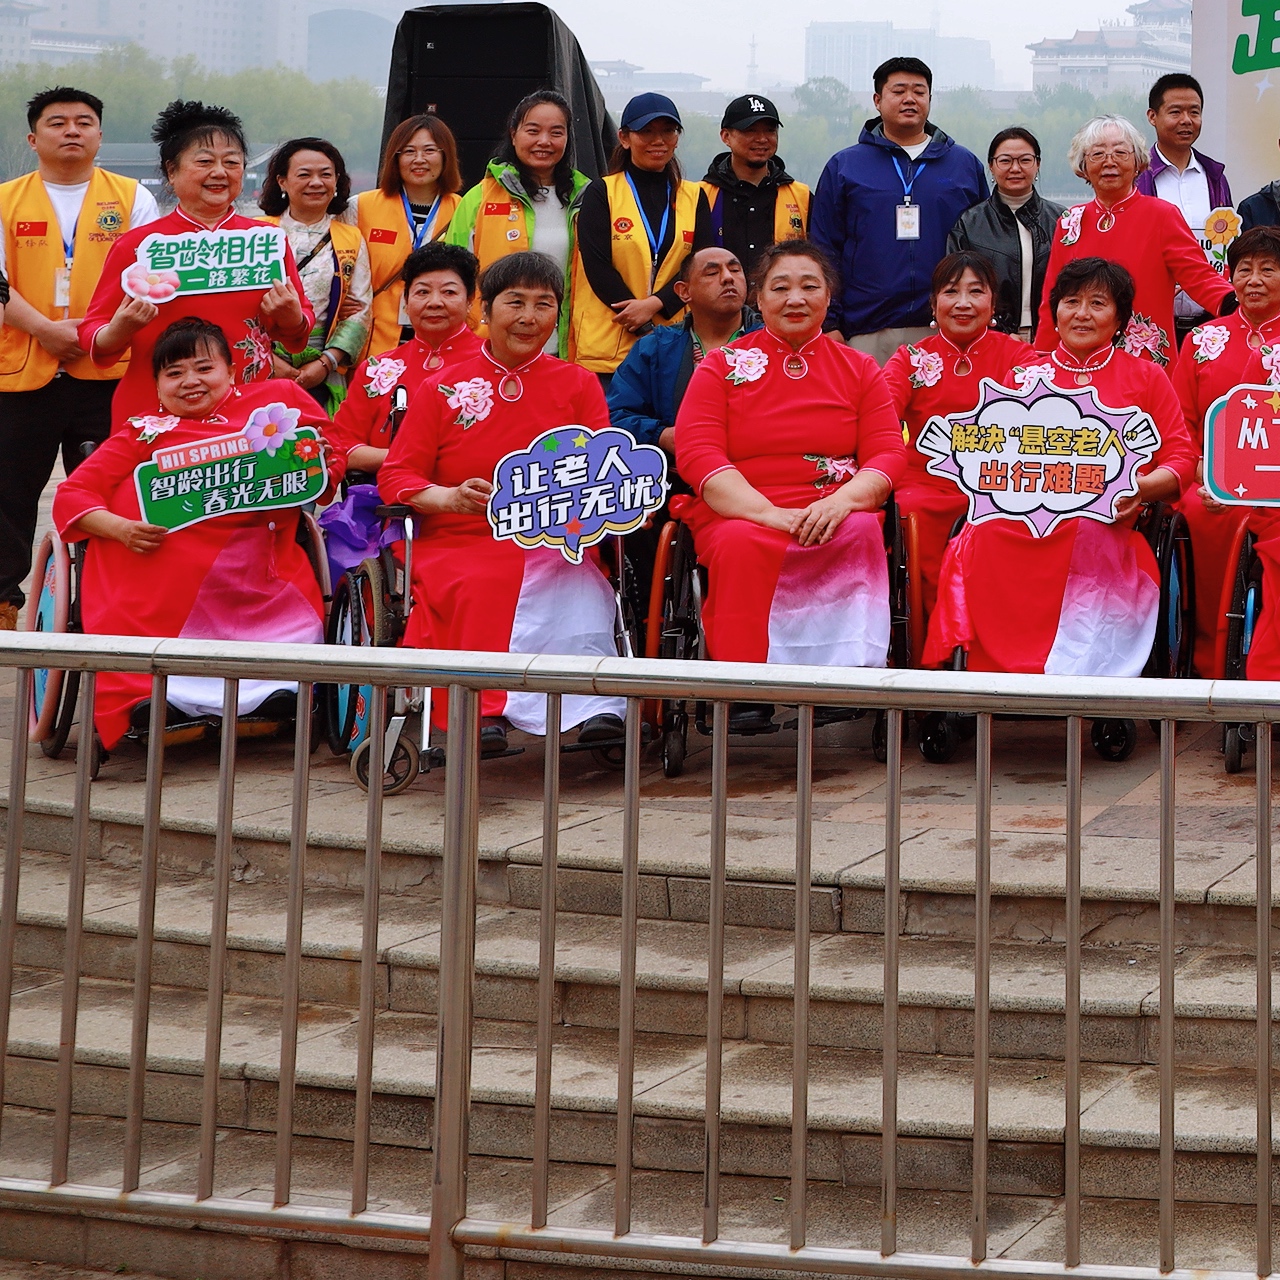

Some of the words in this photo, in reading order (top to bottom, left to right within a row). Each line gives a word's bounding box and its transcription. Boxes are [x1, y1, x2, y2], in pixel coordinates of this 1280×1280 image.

[748, 96, 766, 113] LA
[146, 232, 279, 271] 智龄相伴
[187, 266, 272, 288] 一路繁花
[161, 452, 186, 470] HI!
[189, 438, 250, 465] SPRING
[511, 445, 632, 497] 让老人
[149, 455, 258, 501] 智龄出行
[202, 469, 309, 516] 春光无限
[979, 460, 1108, 495] 出行难题
[497, 476, 656, 537] 出行无忧
